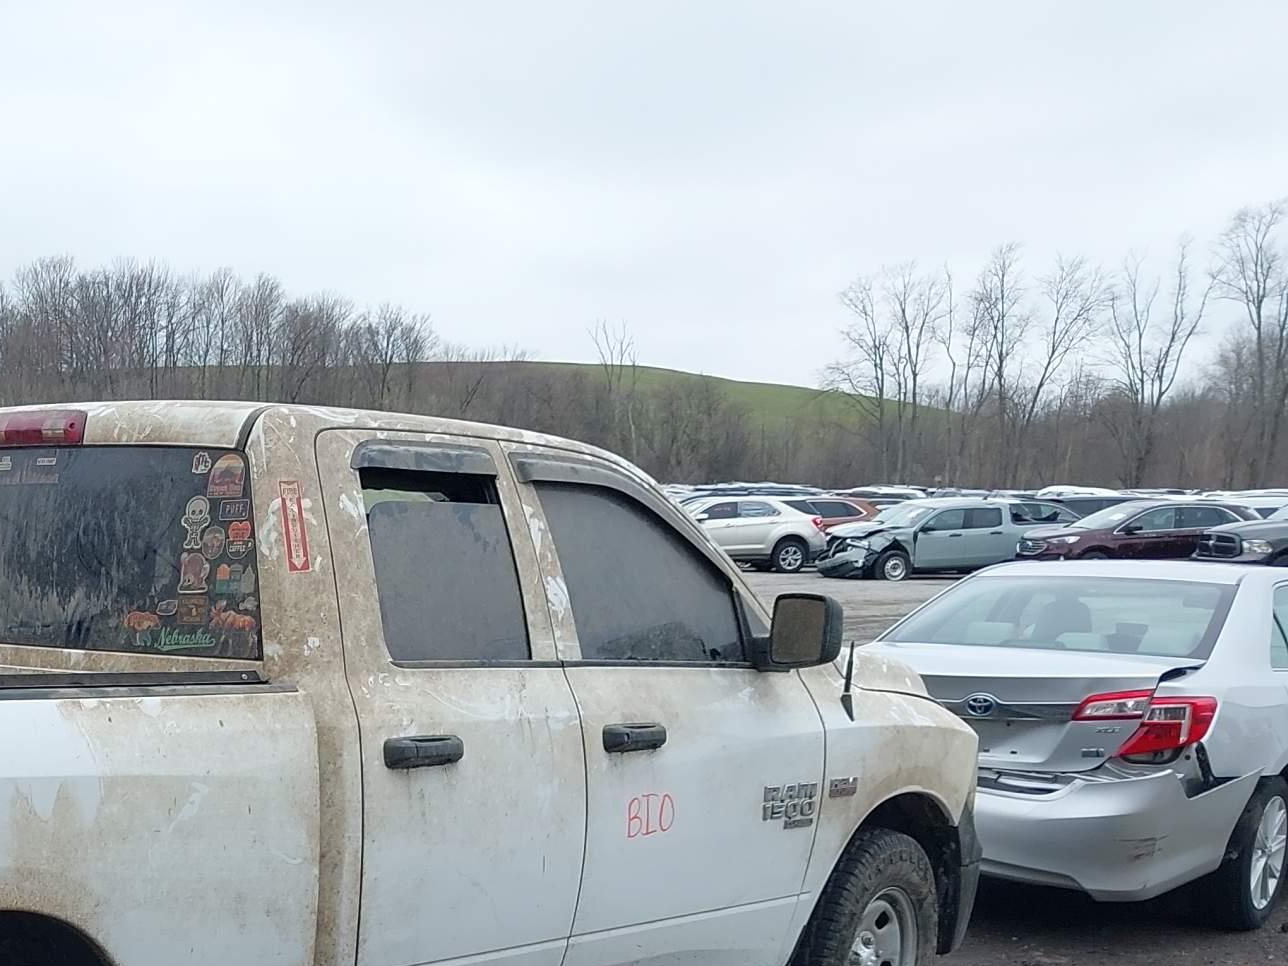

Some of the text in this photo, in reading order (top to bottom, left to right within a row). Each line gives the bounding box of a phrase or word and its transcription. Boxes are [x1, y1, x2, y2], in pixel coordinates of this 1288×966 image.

[283, 487, 298, 495] FIRE
[225, 503, 244, 514] PUFF
[154, 625, 216, 651] Nebraska
[763, 782, 818, 802] RAM
[626, 792, 675, 838] BIO
[761, 799, 815, 821] 1500
